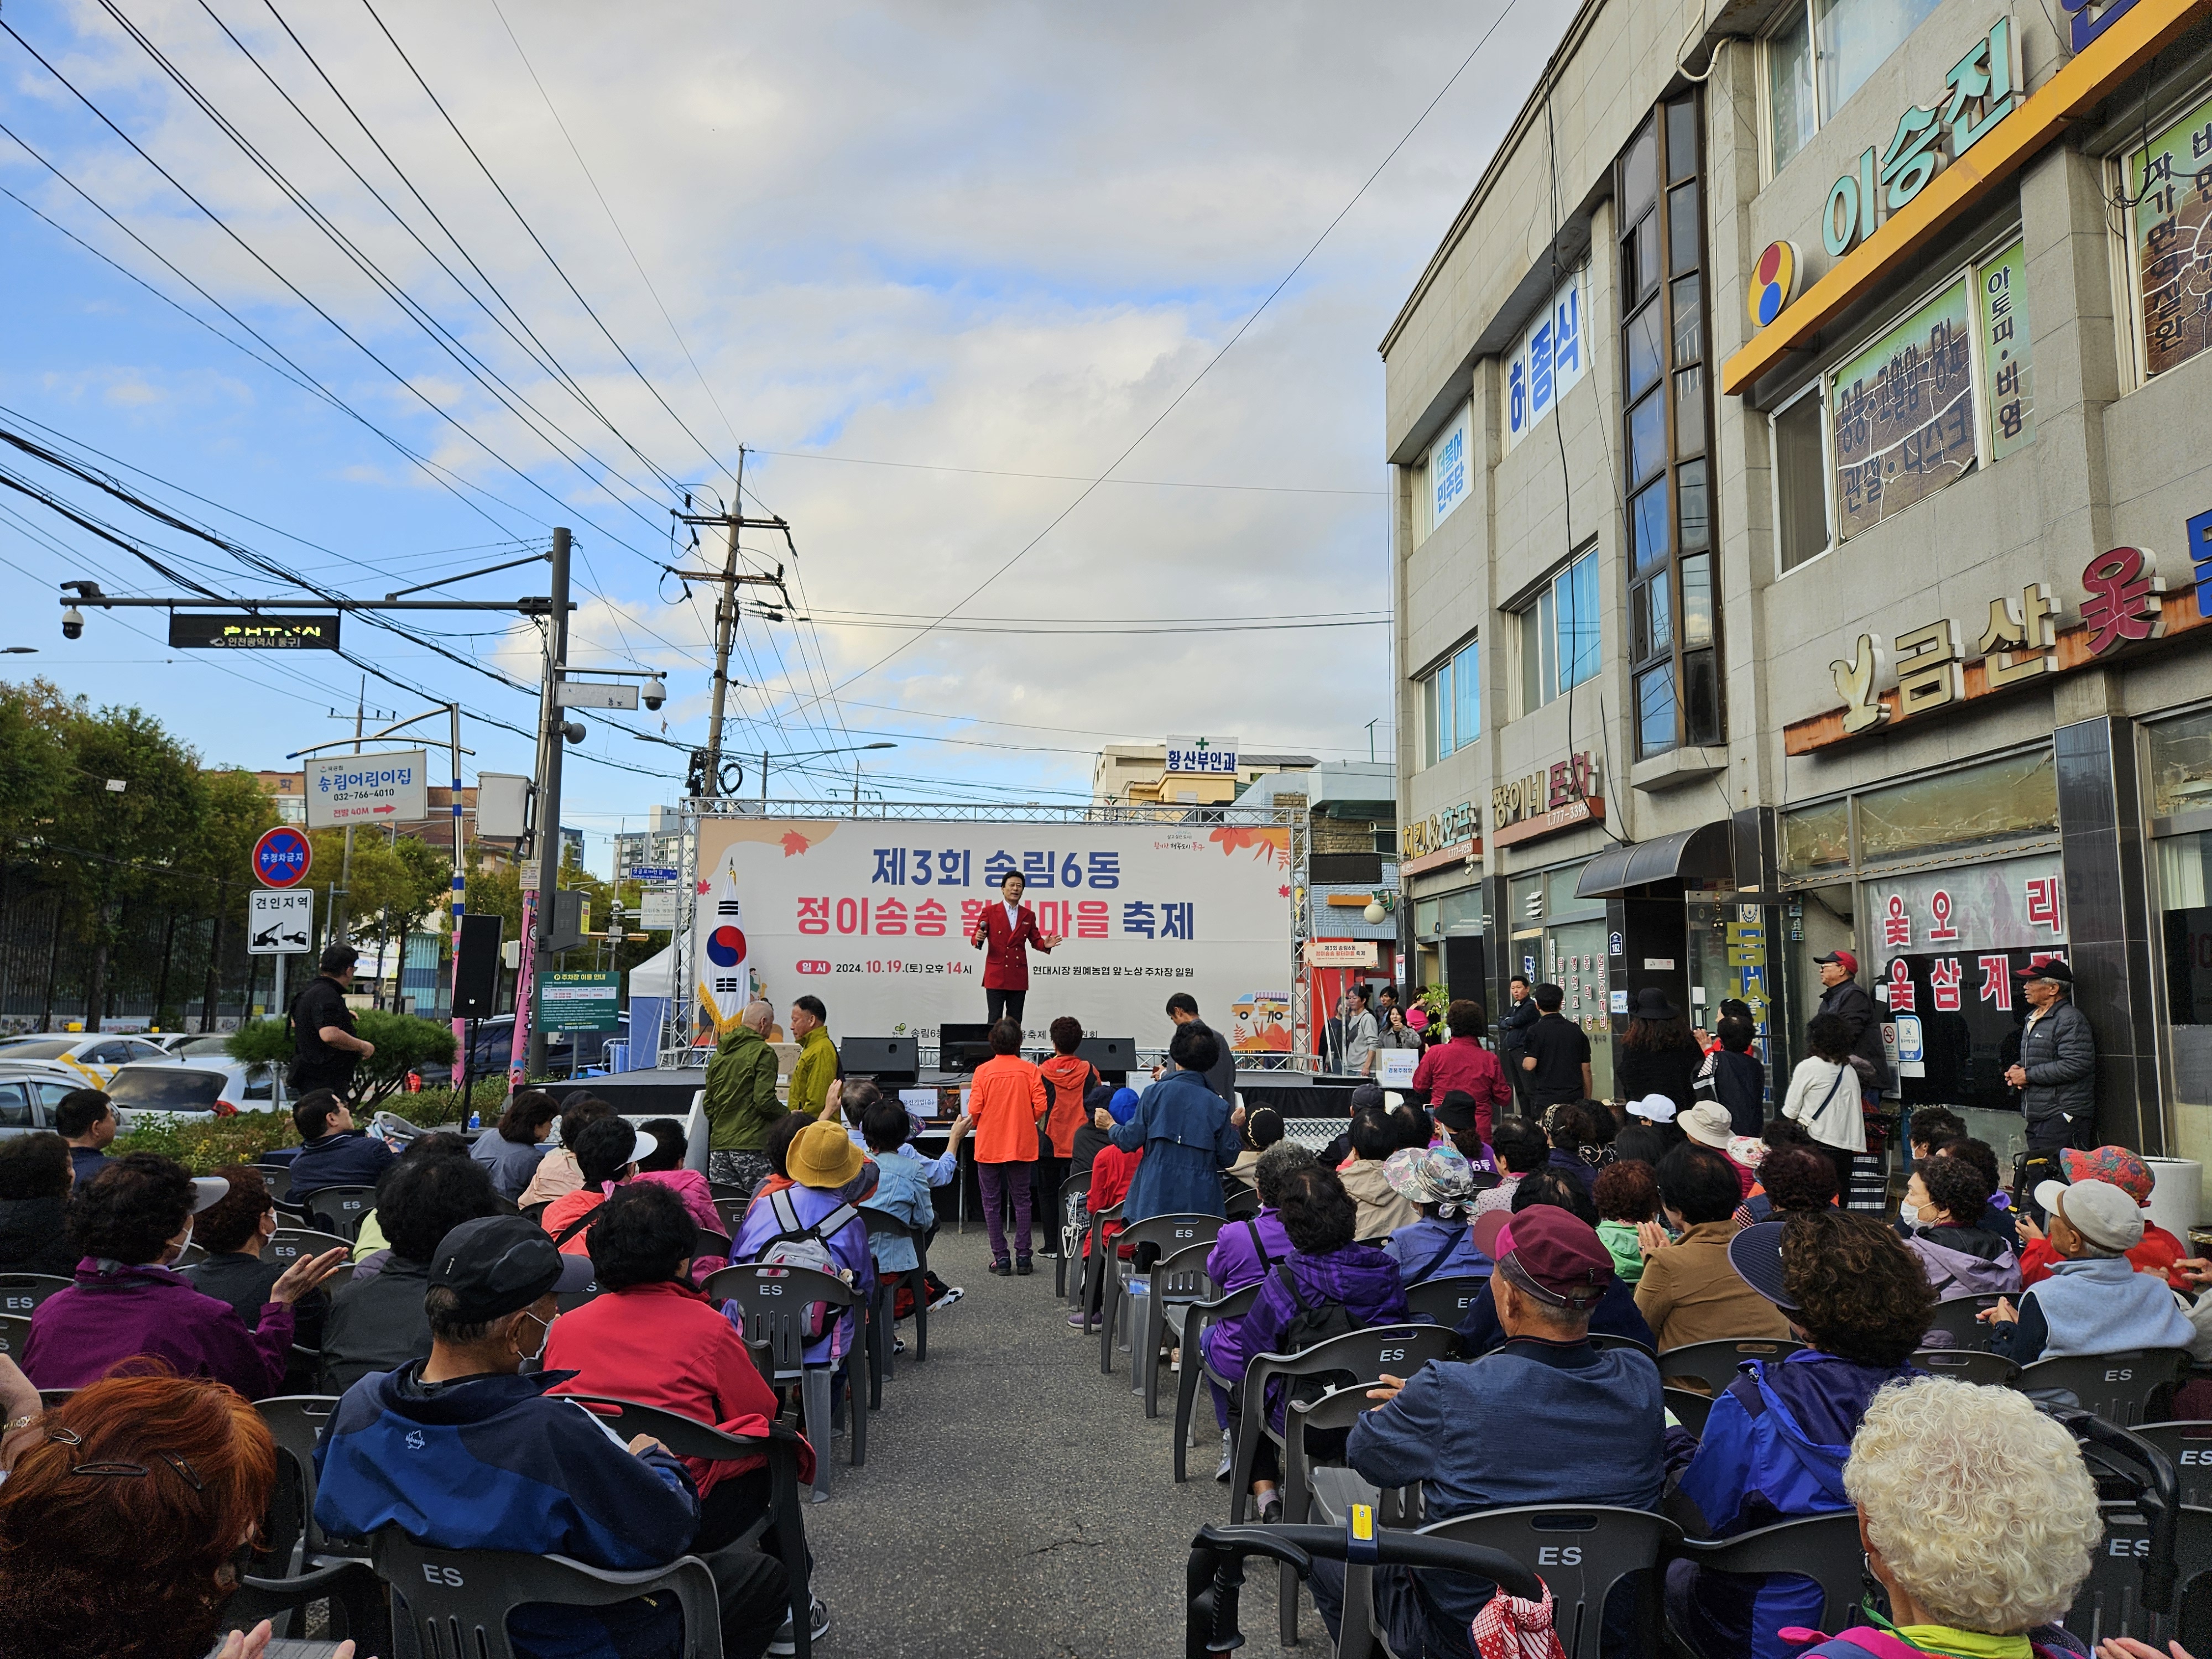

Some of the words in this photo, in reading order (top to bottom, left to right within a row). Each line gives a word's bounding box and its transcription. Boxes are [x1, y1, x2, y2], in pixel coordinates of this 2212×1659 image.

[1823, 15, 2016, 257] 이승진
[2142, 151, 2186, 353] 자가면역질환
[1509, 288, 1579, 434] 허종식
[1437, 427, 1463, 482] 더불어
[1438, 460, 1464, 514] 민주당
[228, 638, 274, 646] 인천광역시
[1168, 750, 1236, 772] 황산부인과
[318, 768, 411, 792] 송림어린이집
[333, 789, 394, 801] 032-766-4010
[1492, 770, 1546, 828] 짱이네
[1549, 751, 1595, 807] 포차
[333, 808, 348, 817] 전방
[351, 807, 369, 815] 40M
[1547, 803, 1588, 827] T.777-3399
[1191, 842, 1205, 851] 동구
[261, 852, 304, 863] 주정차금지
[872, 847, 971, 887] 제3회
[984, 849, 1120, 889] 송림6동
[256, 896, 308, 909] 견인지역
[797, 896, 947, 937] 정이송송
[961, 899, 1109, 938] 활마을
[1123, 900, 1194, 940] 축제
[1611, 943, 1620, 952] 182
[925, 964, 944, 974] 오후
[946, 961, 972, 974] 14시
[1033, 966, 1070, 975] 현대시장
[1073, 966, 1110, 976] 원예농협
[1113, 967, 1122, 976] 앞
[1124, 967, 1143, 977] 노상
[1145, 967, 1172, 977] 주차장
[1175, 968, 1194, 977] 일원
[1584, 954, 1593, 1030] 동태탕
[1597, 953, 1608, 1030] 얼큰수제비
[343, 1201, 361, 1209] ES
[1175, 1229, 1193, 1238] ES
[275, 1246, 297, 1256] ES
[760, 1285, 782, 1295] ES
[6, 1297, 34, 1309] ES
[1379, 1349, 1405, 1362] ES
[2104, 1369, 2133, 1381] ES
[1537, 1546, 1583, 1566] ES
[422, 1563, 465, 1587] ES
